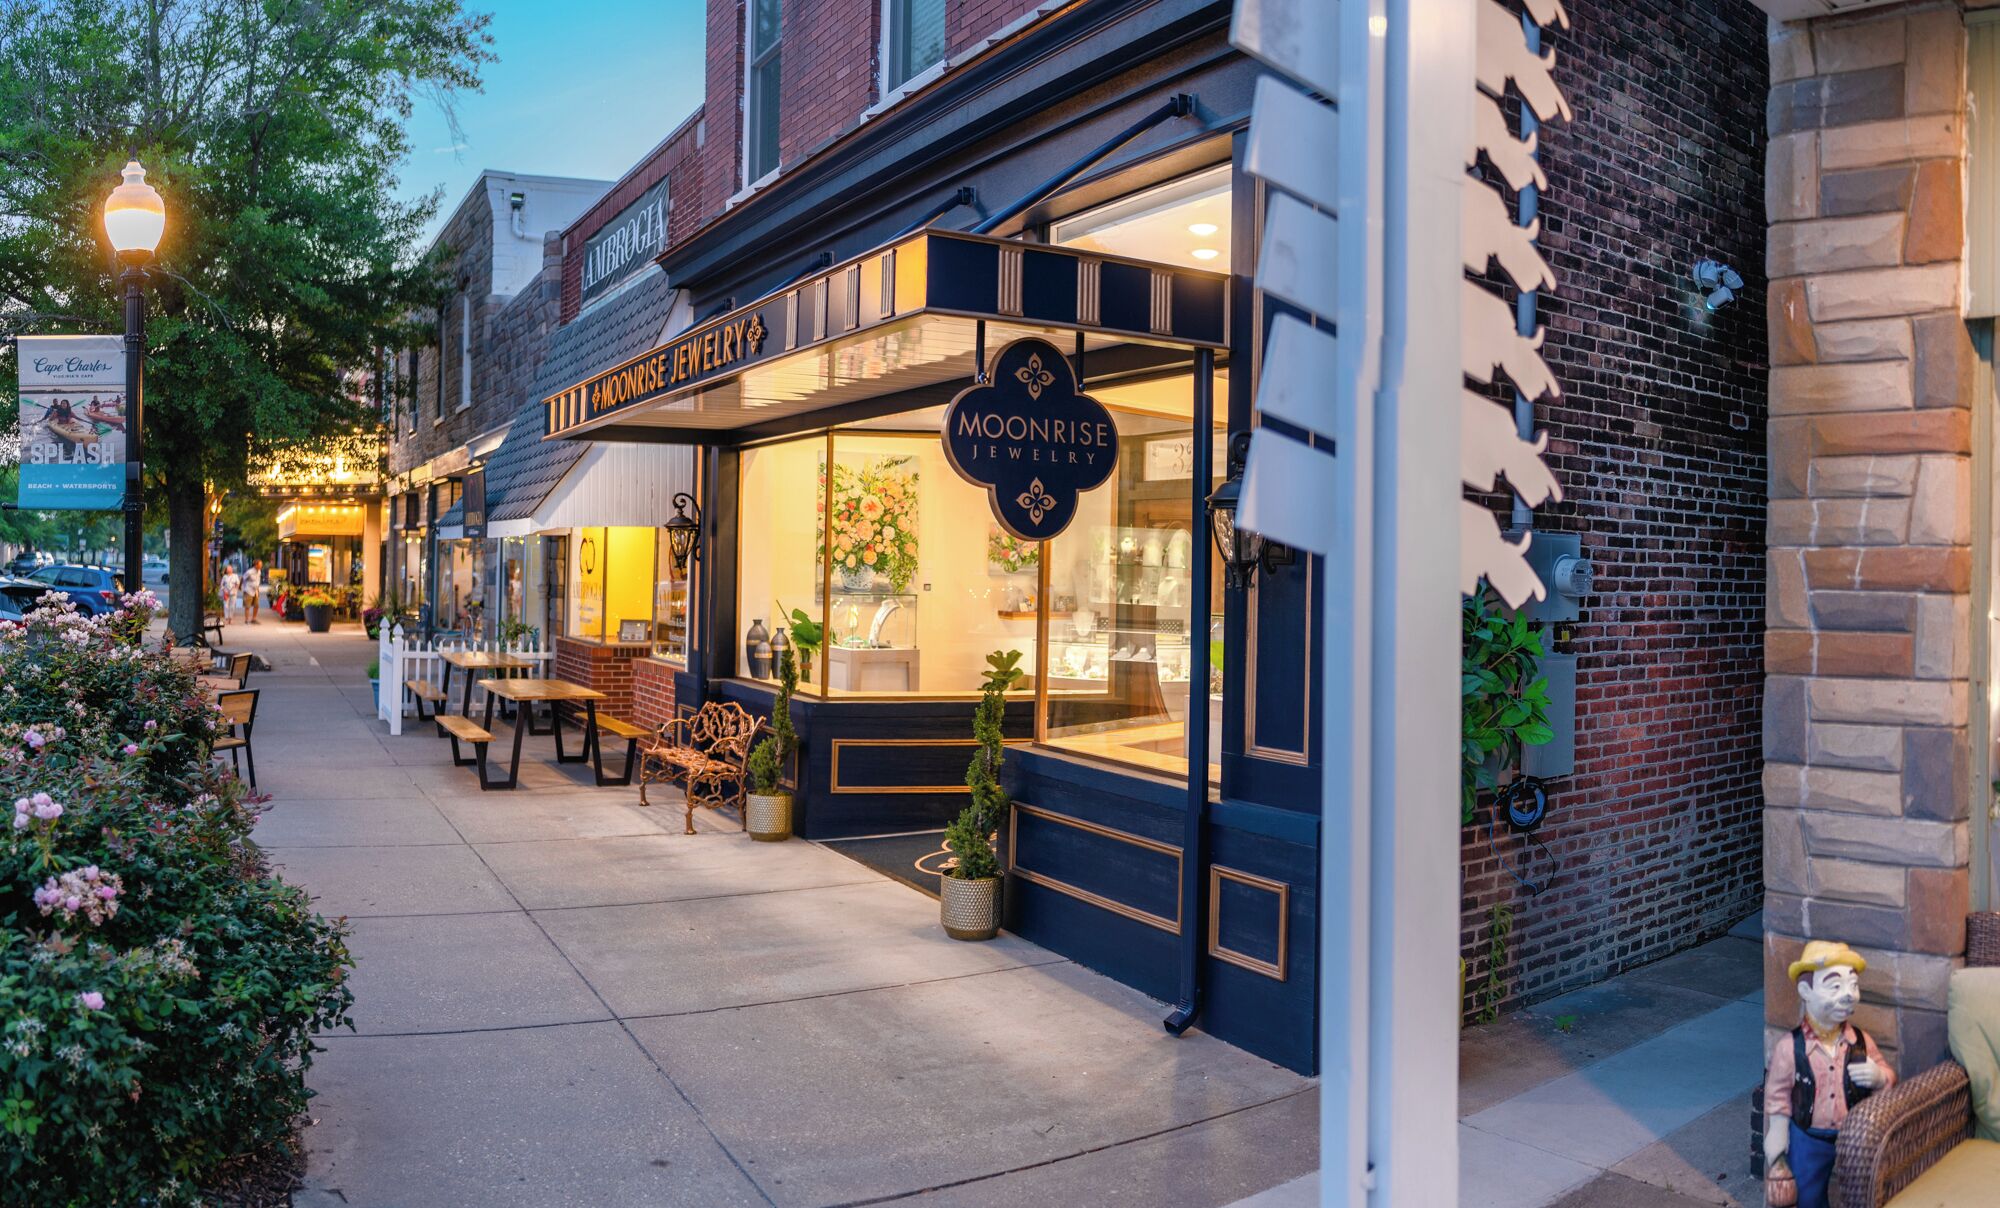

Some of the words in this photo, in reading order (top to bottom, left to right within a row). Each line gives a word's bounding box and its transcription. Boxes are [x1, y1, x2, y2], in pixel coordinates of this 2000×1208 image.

[583, 197, 665, 292] AMBROGIA
[33, 357, 63, 376] Cape
[65, 357, 112, 373] Charles
[601, 354, 665, 410] MOONRISE
[671, 318, 747, 384] JEWELRY
[958, 411, 1108, 447] MOONRISE
[30, 442, 116, 465] SPLASH
[972, 445, 1096, 465] JEWELRY
